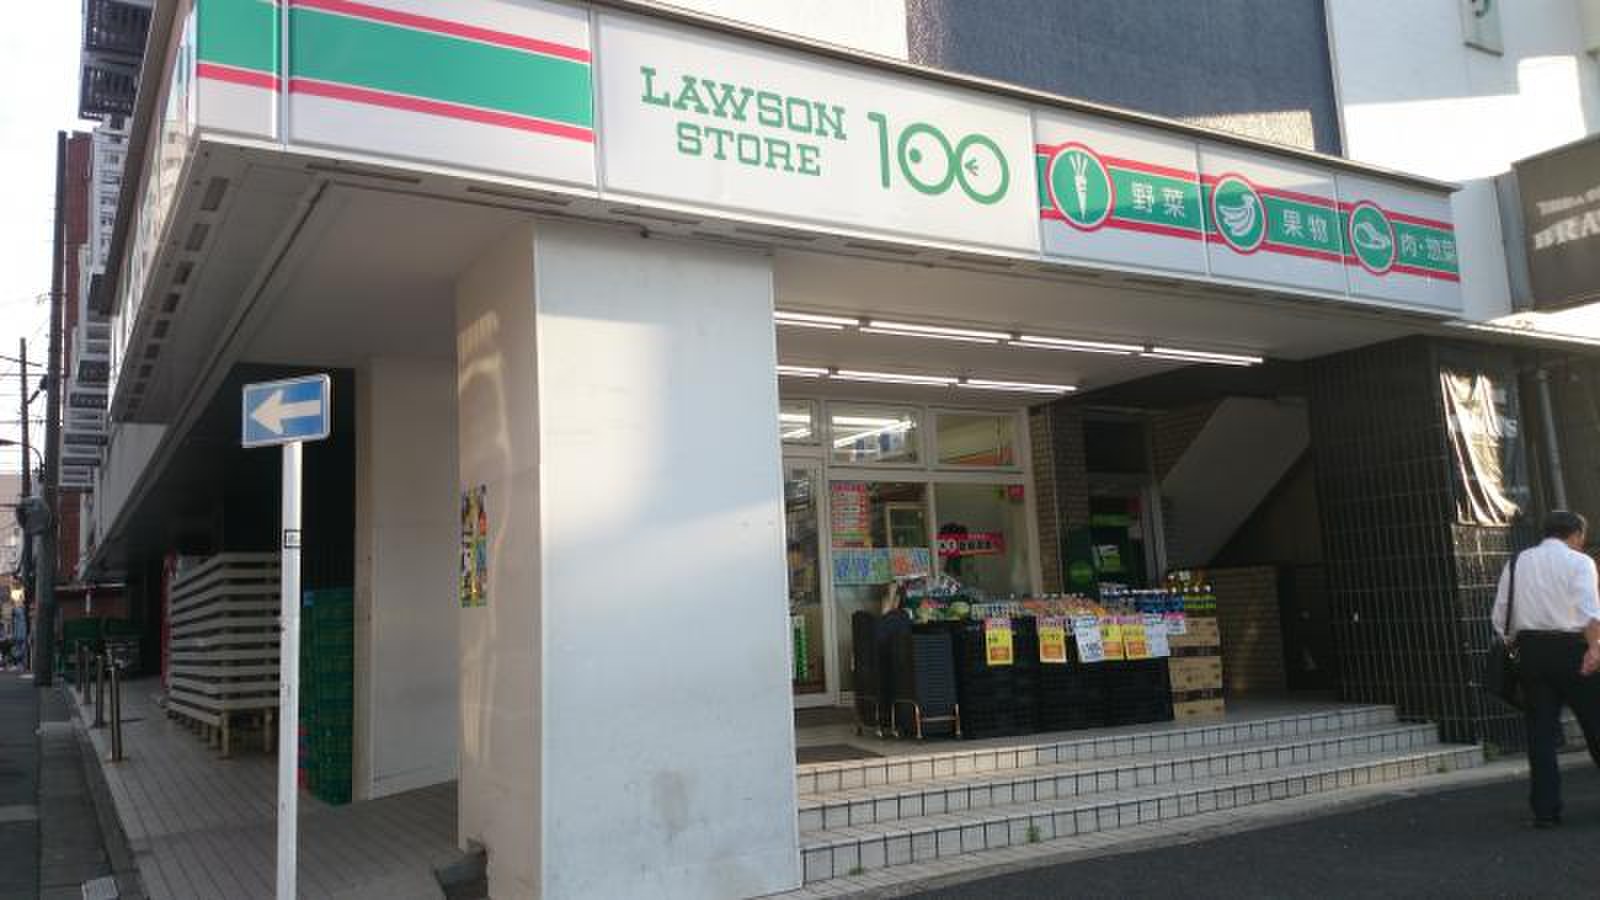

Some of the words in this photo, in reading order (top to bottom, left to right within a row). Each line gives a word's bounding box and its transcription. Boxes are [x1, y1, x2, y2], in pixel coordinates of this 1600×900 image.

[640, 66, 847, 140] LAWSON
[677, 121, 820, 177] STORE
[868, 111, 1010, 205] 100
[1131, 181, 1186, 218] 野菜
[1283, 208, 1328, 243] 果物
